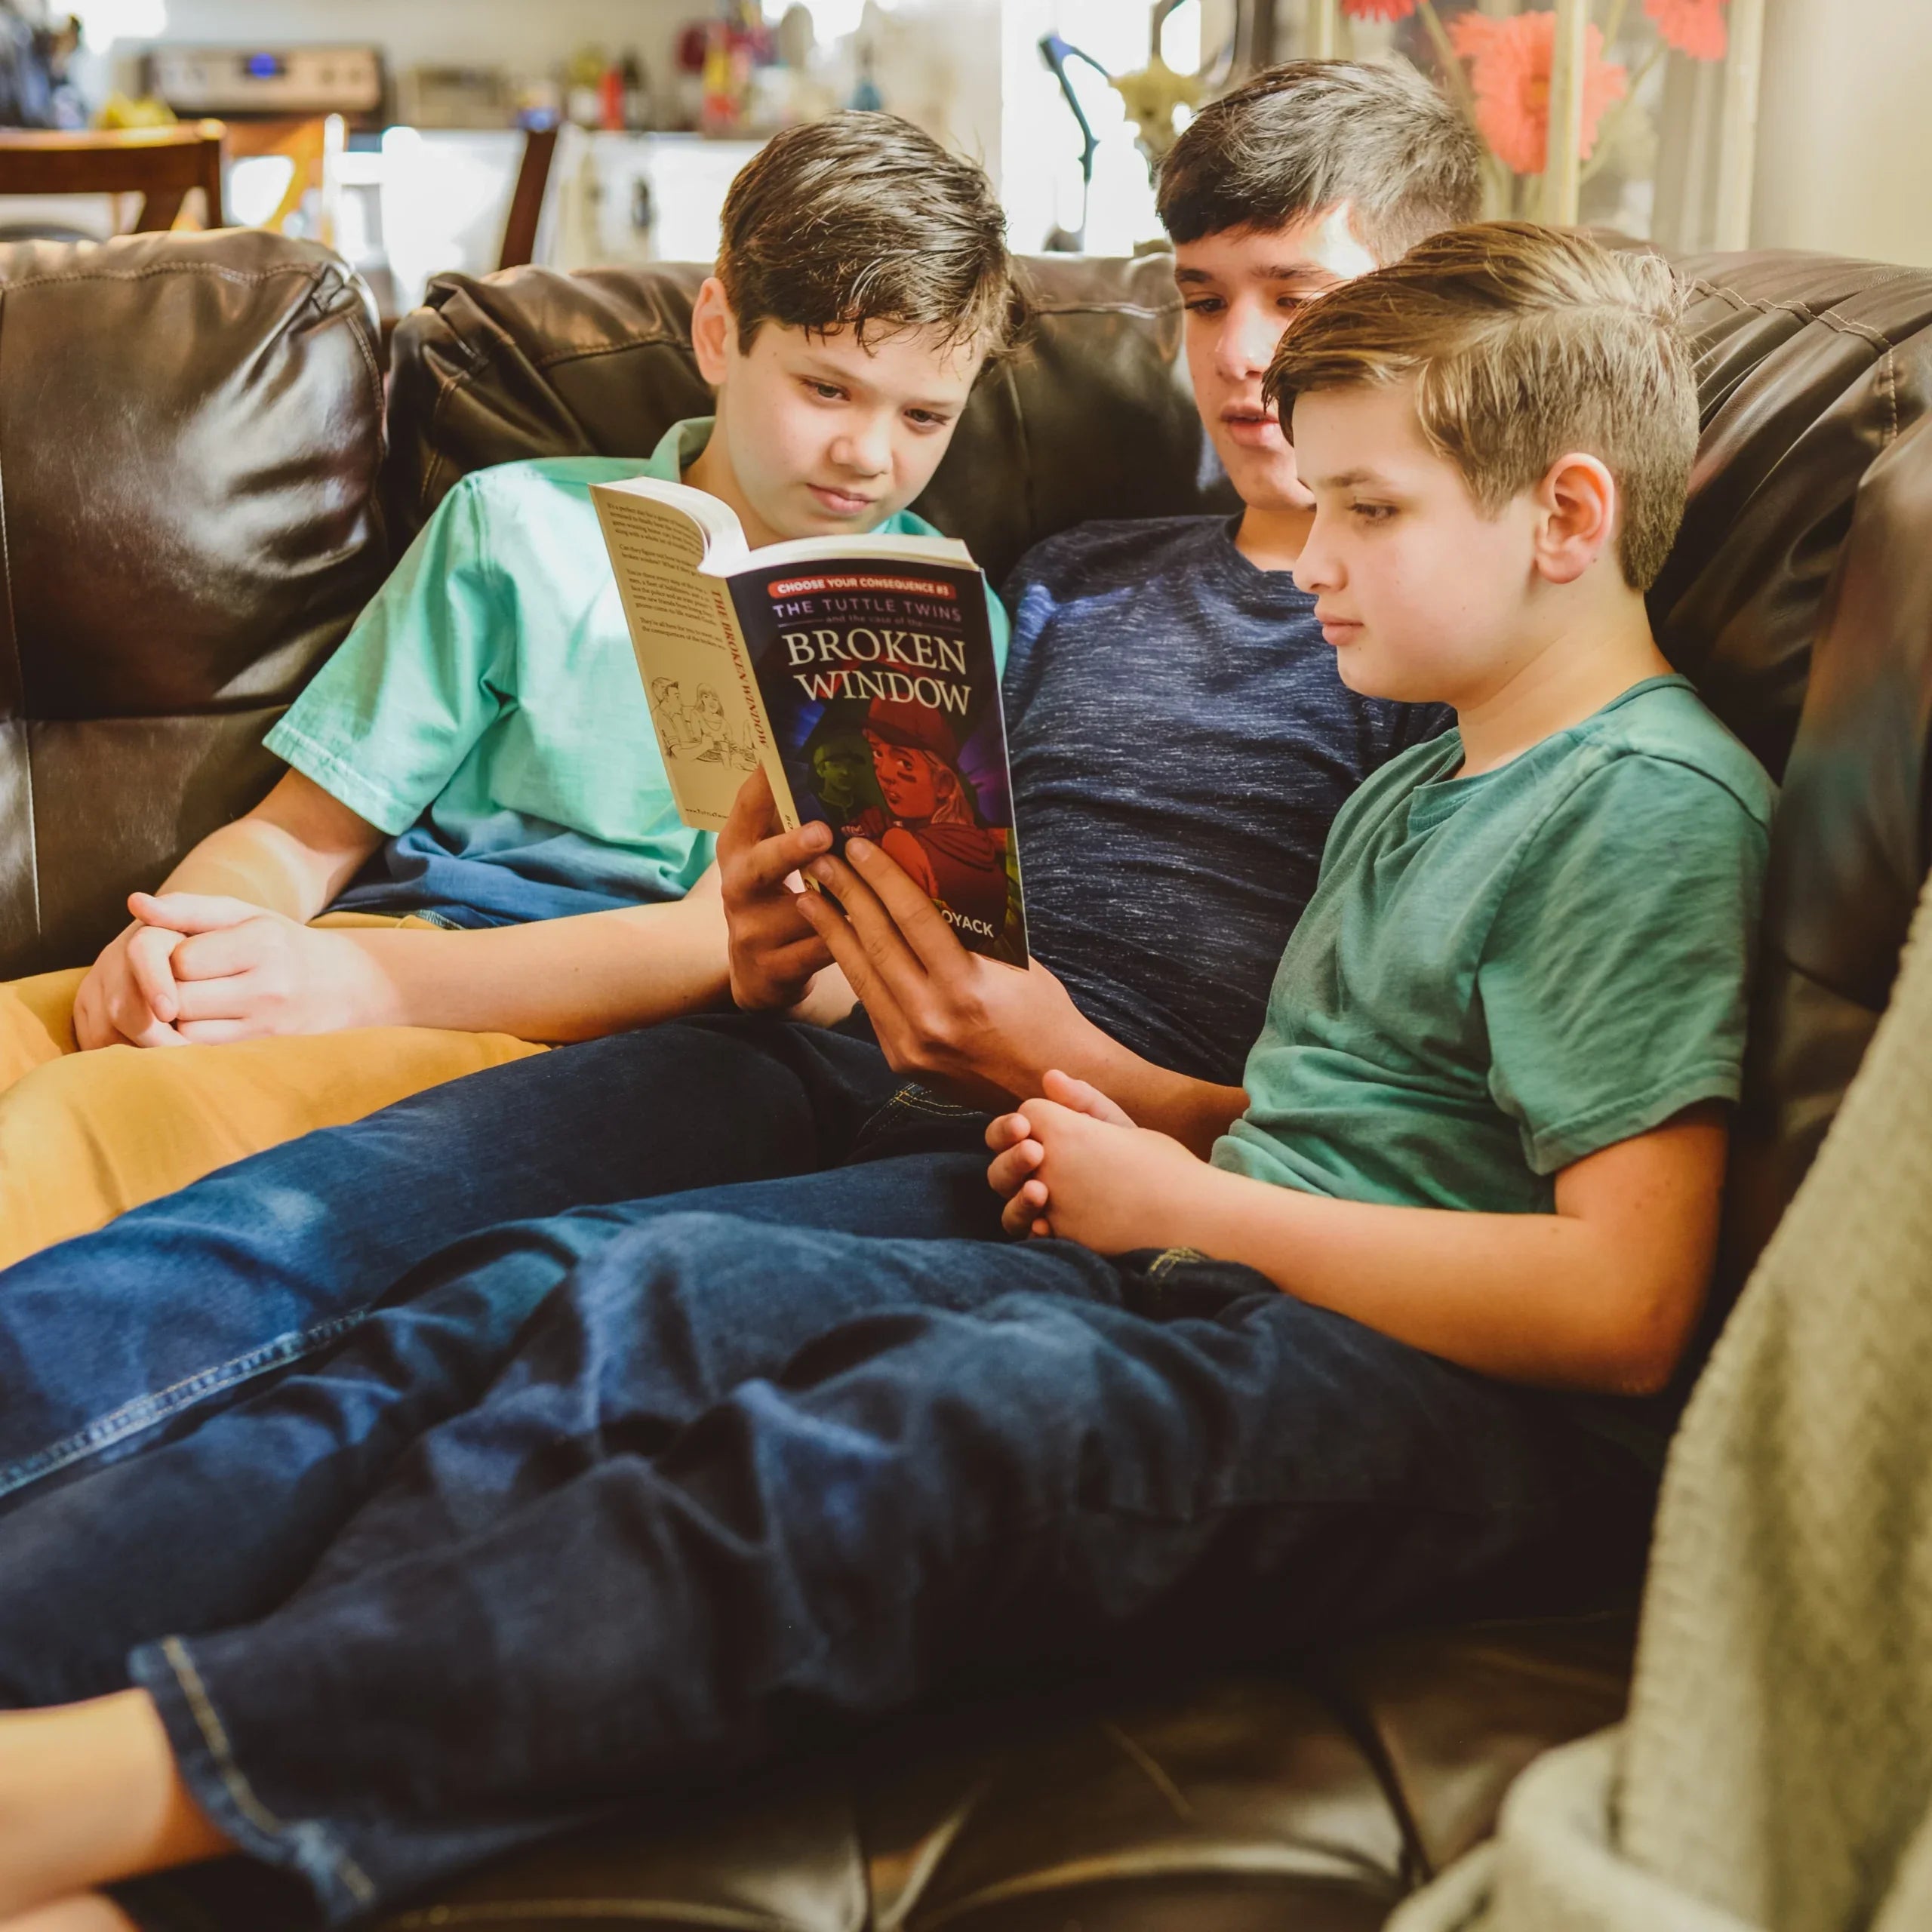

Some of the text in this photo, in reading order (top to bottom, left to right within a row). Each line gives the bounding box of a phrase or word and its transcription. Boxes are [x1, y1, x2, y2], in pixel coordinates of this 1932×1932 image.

[778, 579, 825, 594] CHOOSE
[827, 578, 857, 588] YOUR
[860, 577, 934, 594] CONSEQUENCE
[773, 598, 962, 622] THE TUTTLE TWINS
[826, 614, 844, 623] and
[893, 617, 904, 625] of
[781, 628, 966, 675] BROKEN
[722, 622, 749, 682] BROKEN
[741, 685, 769, 749] WINDOW
[793, 670, 971, 715] WINDOW
[941, 909, 995, 938] OYACK
